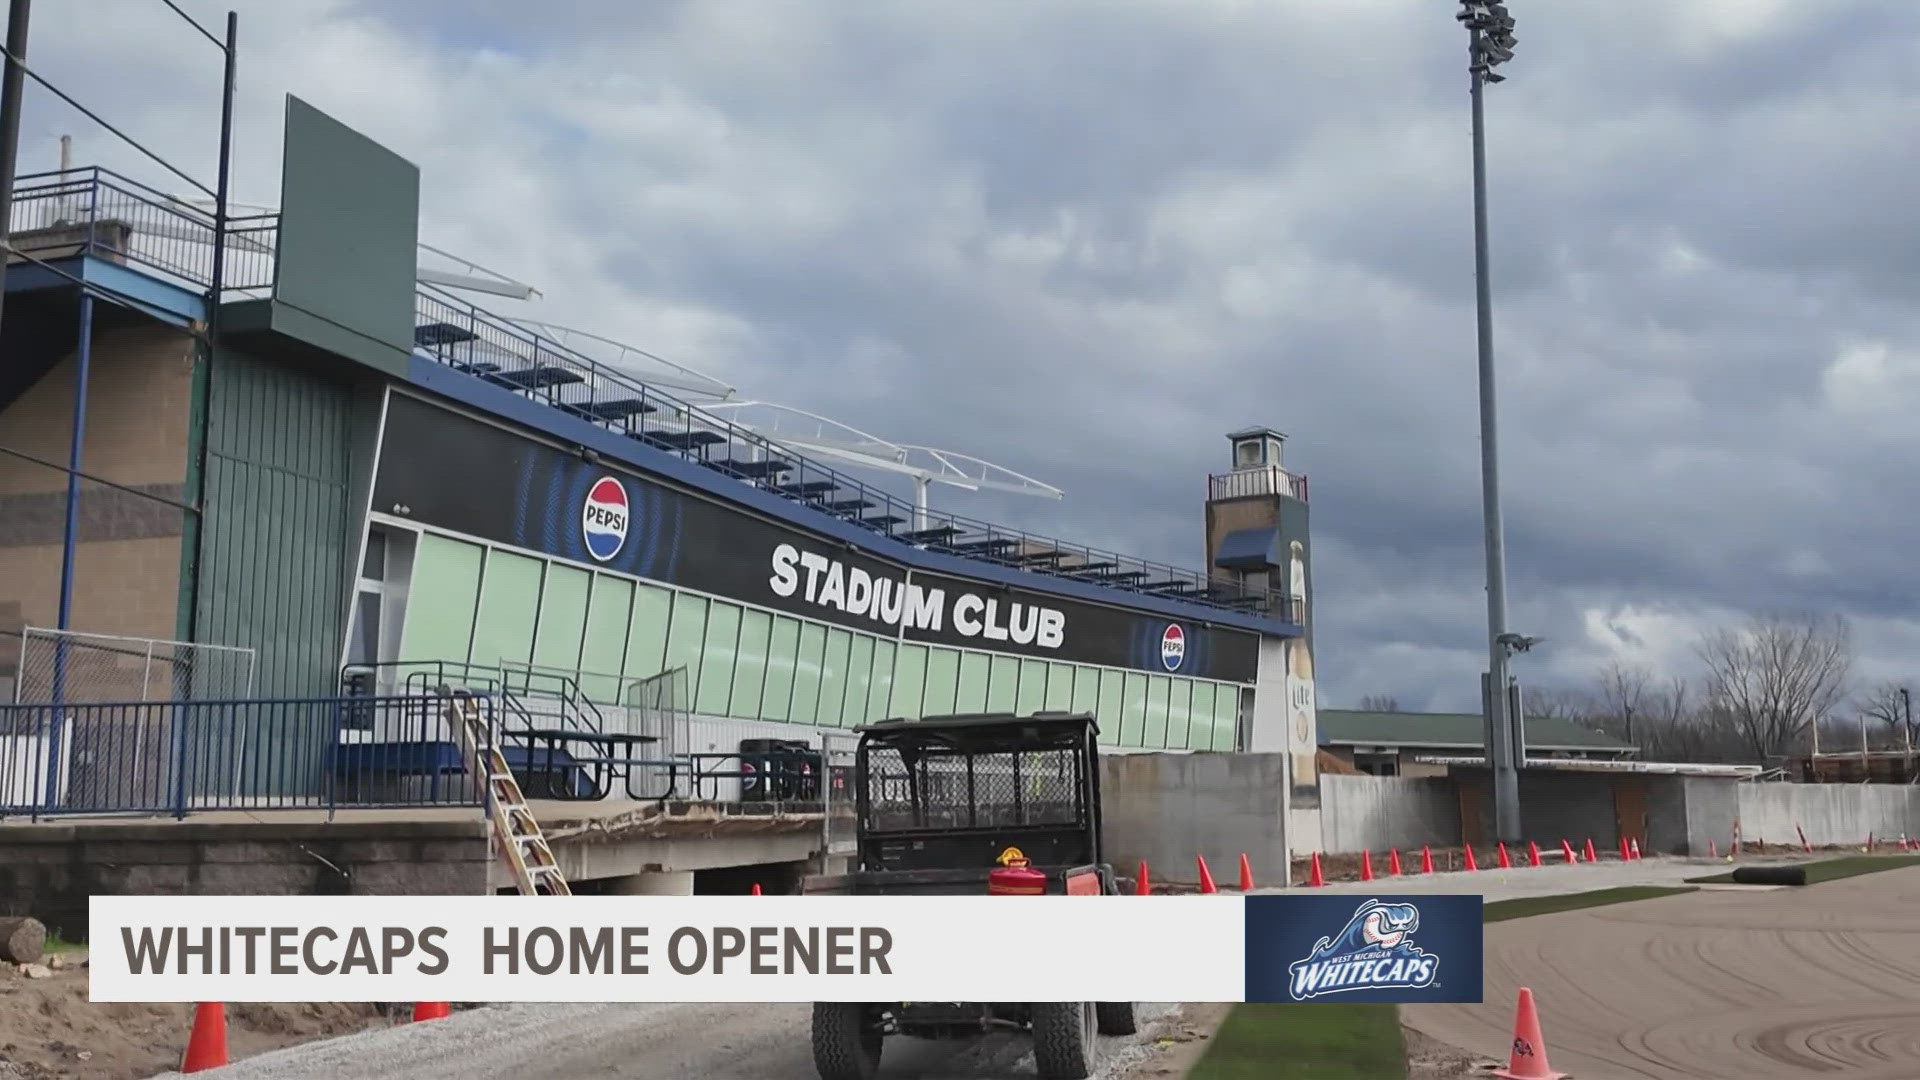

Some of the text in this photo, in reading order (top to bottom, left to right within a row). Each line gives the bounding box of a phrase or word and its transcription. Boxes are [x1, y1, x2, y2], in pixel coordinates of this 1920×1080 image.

[587, 505, 625, 532] PEPSI
[769, 543, 1066, 648] STADIUM CLUB
[1164, 641, 1183, 653] PEPSI
